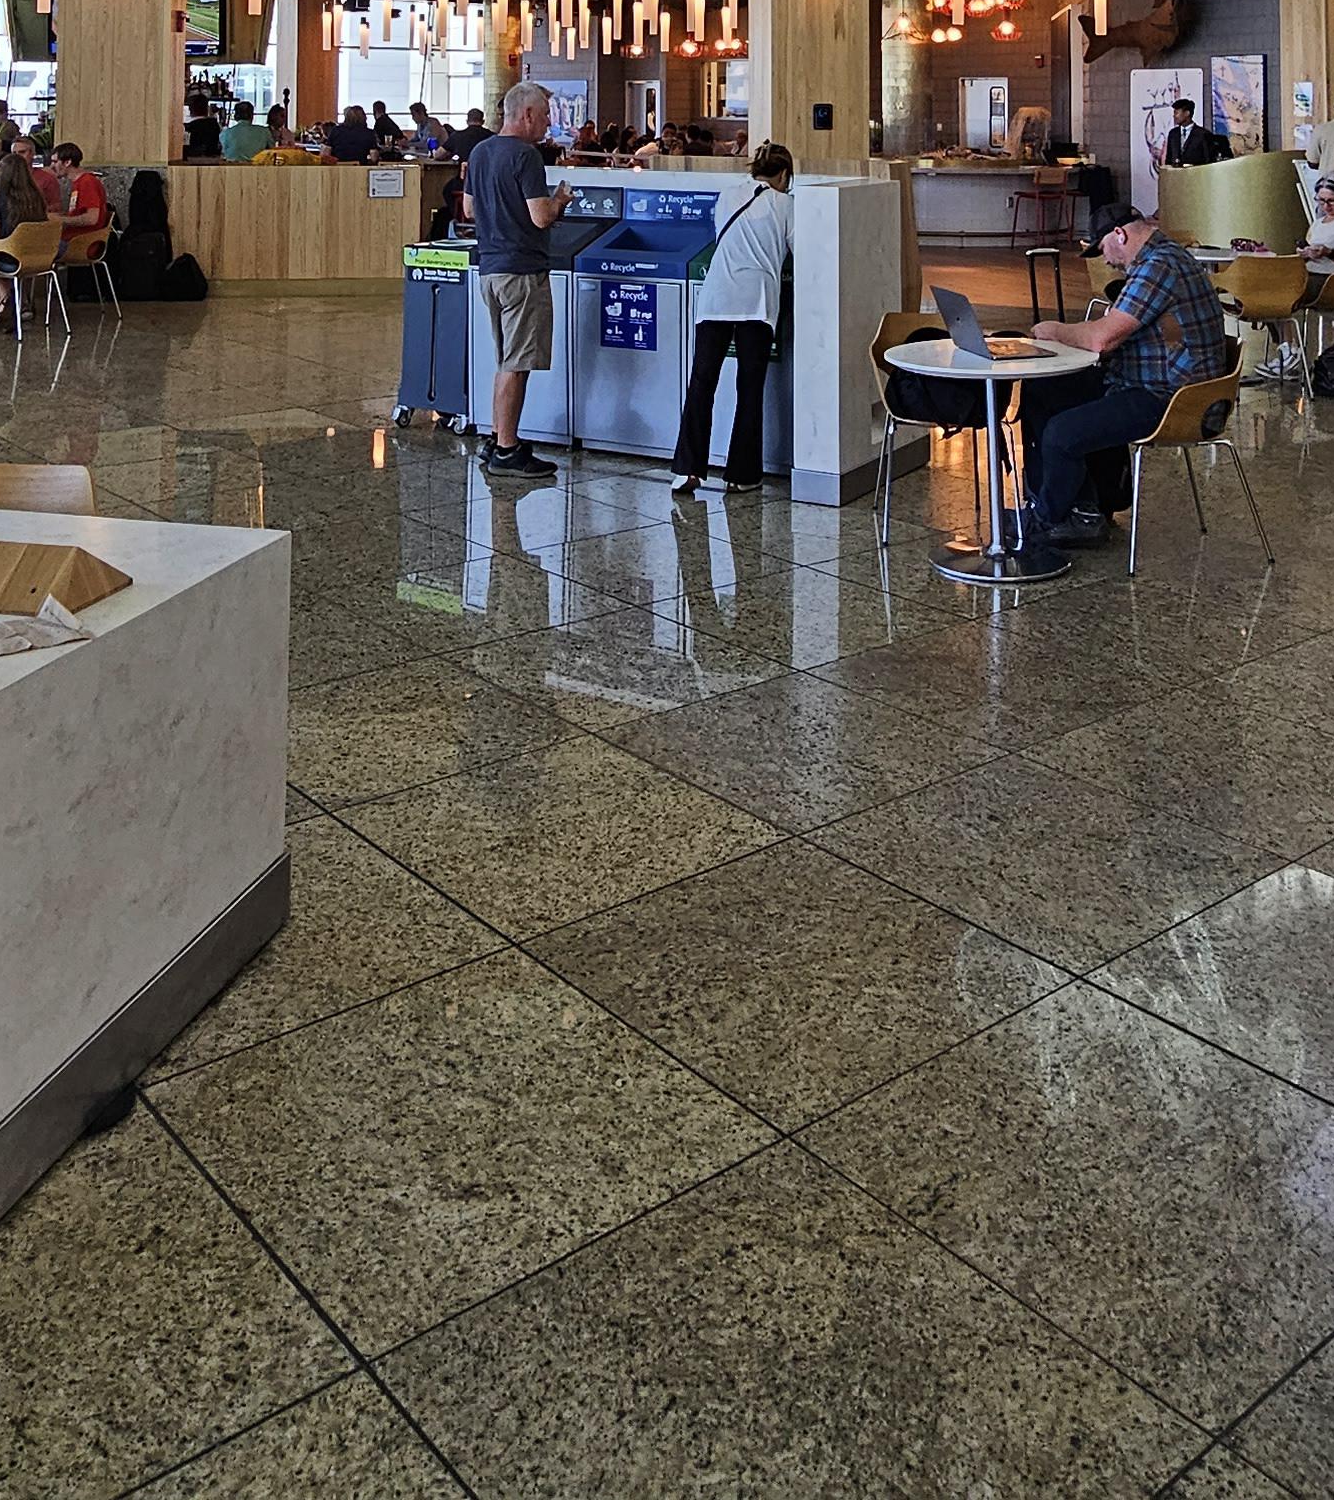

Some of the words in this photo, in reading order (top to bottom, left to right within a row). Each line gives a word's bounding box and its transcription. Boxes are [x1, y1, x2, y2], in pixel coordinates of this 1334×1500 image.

[668, 194, 694, 204] Recycle
[610, 262, 636, 272] Recycle
[620, 290, 649, 302] Recycle
